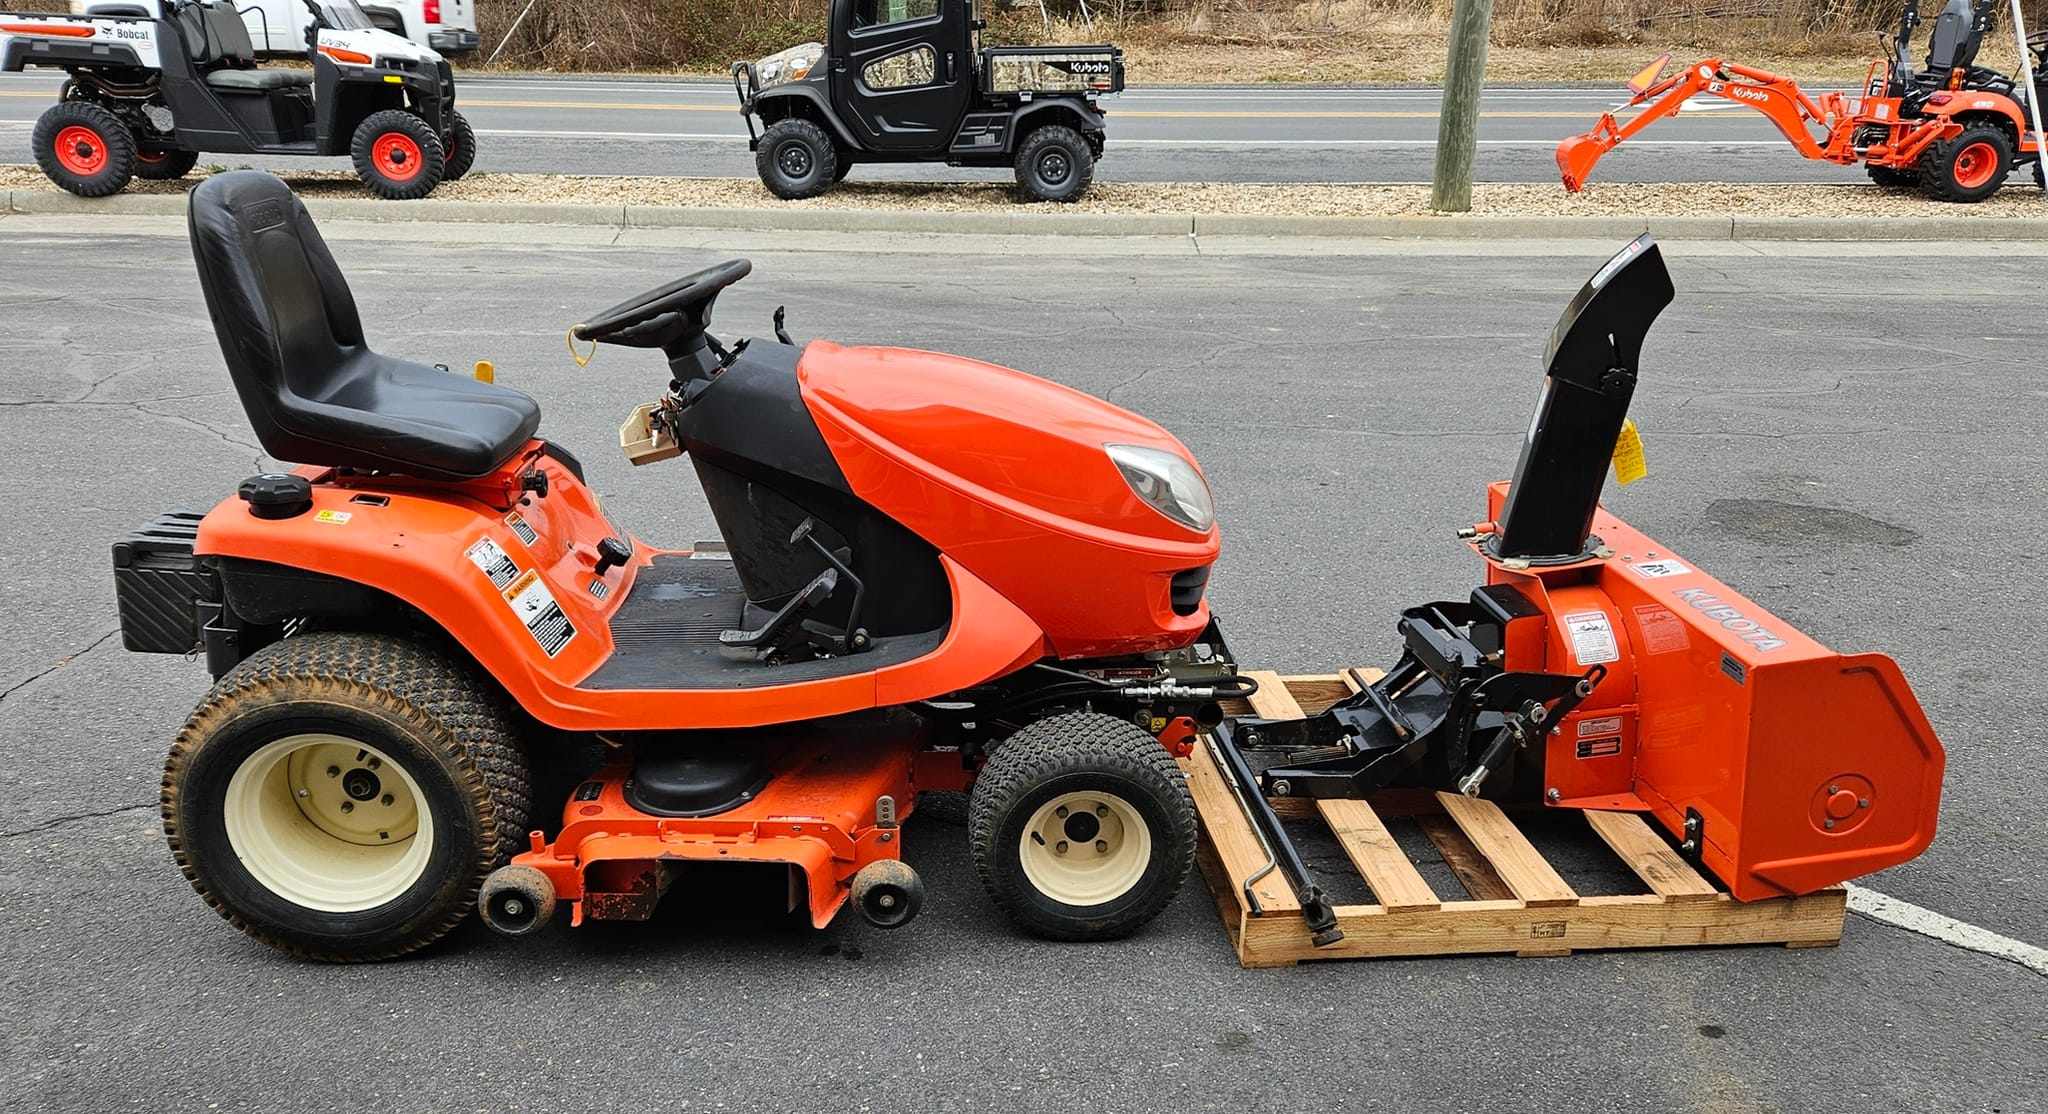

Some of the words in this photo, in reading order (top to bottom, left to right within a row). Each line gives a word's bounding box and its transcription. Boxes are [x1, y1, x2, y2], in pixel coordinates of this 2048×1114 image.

[116, 28, 149, 40] Bobcat
[320, 36, 351, 49] UV34
[1070, 62, 1109, 73] Kubota
[1733, 87, 1769, 101] Kubota
[1671, 587, 1788, 652] KUBOTA
